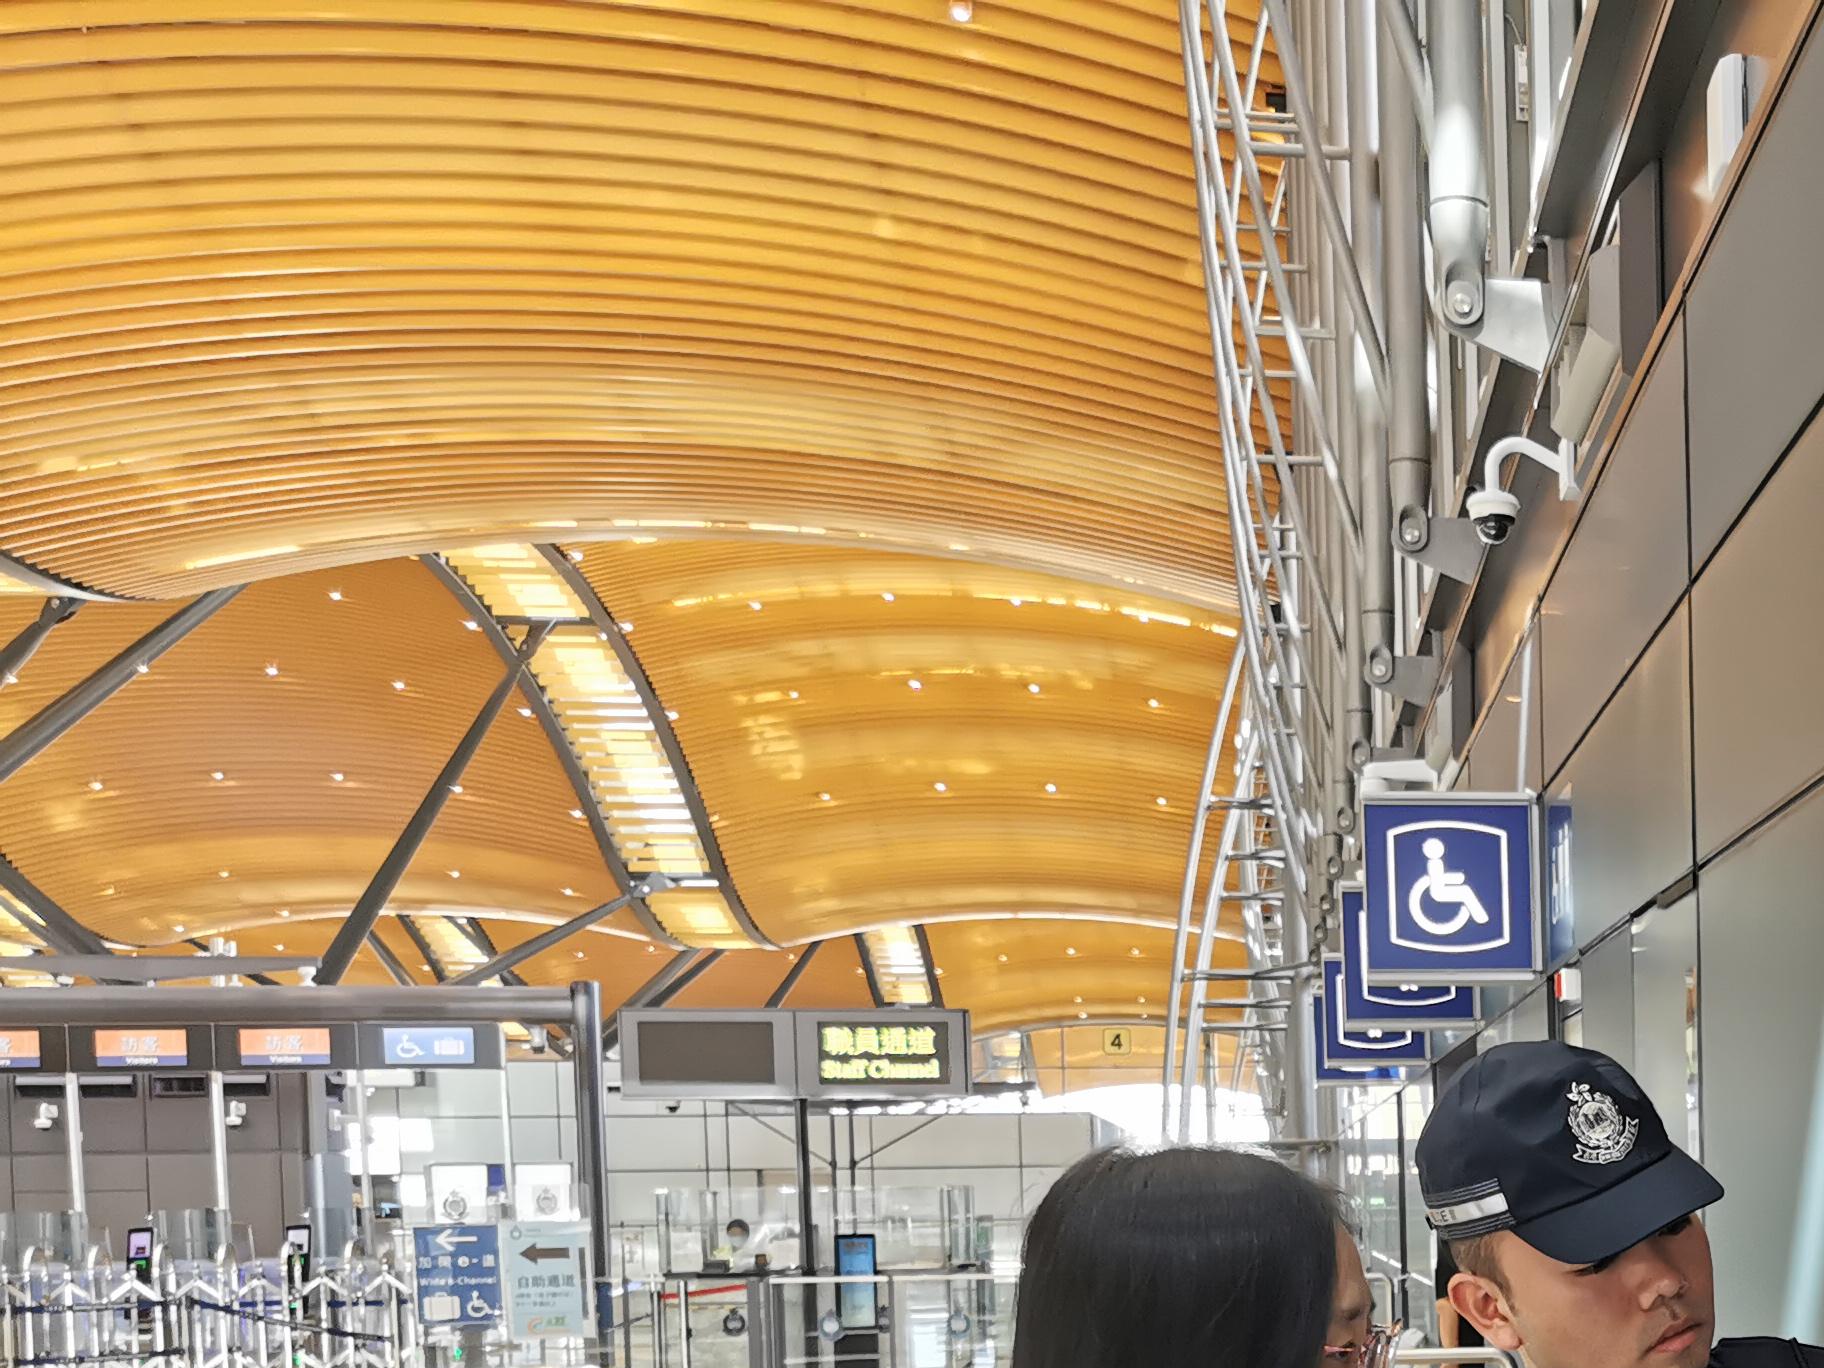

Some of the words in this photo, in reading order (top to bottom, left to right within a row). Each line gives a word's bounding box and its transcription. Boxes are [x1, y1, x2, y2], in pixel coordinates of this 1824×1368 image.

[1111, 1033, 1123, 1050] 4
[517, 1273, 575, 1289] 自助通道
